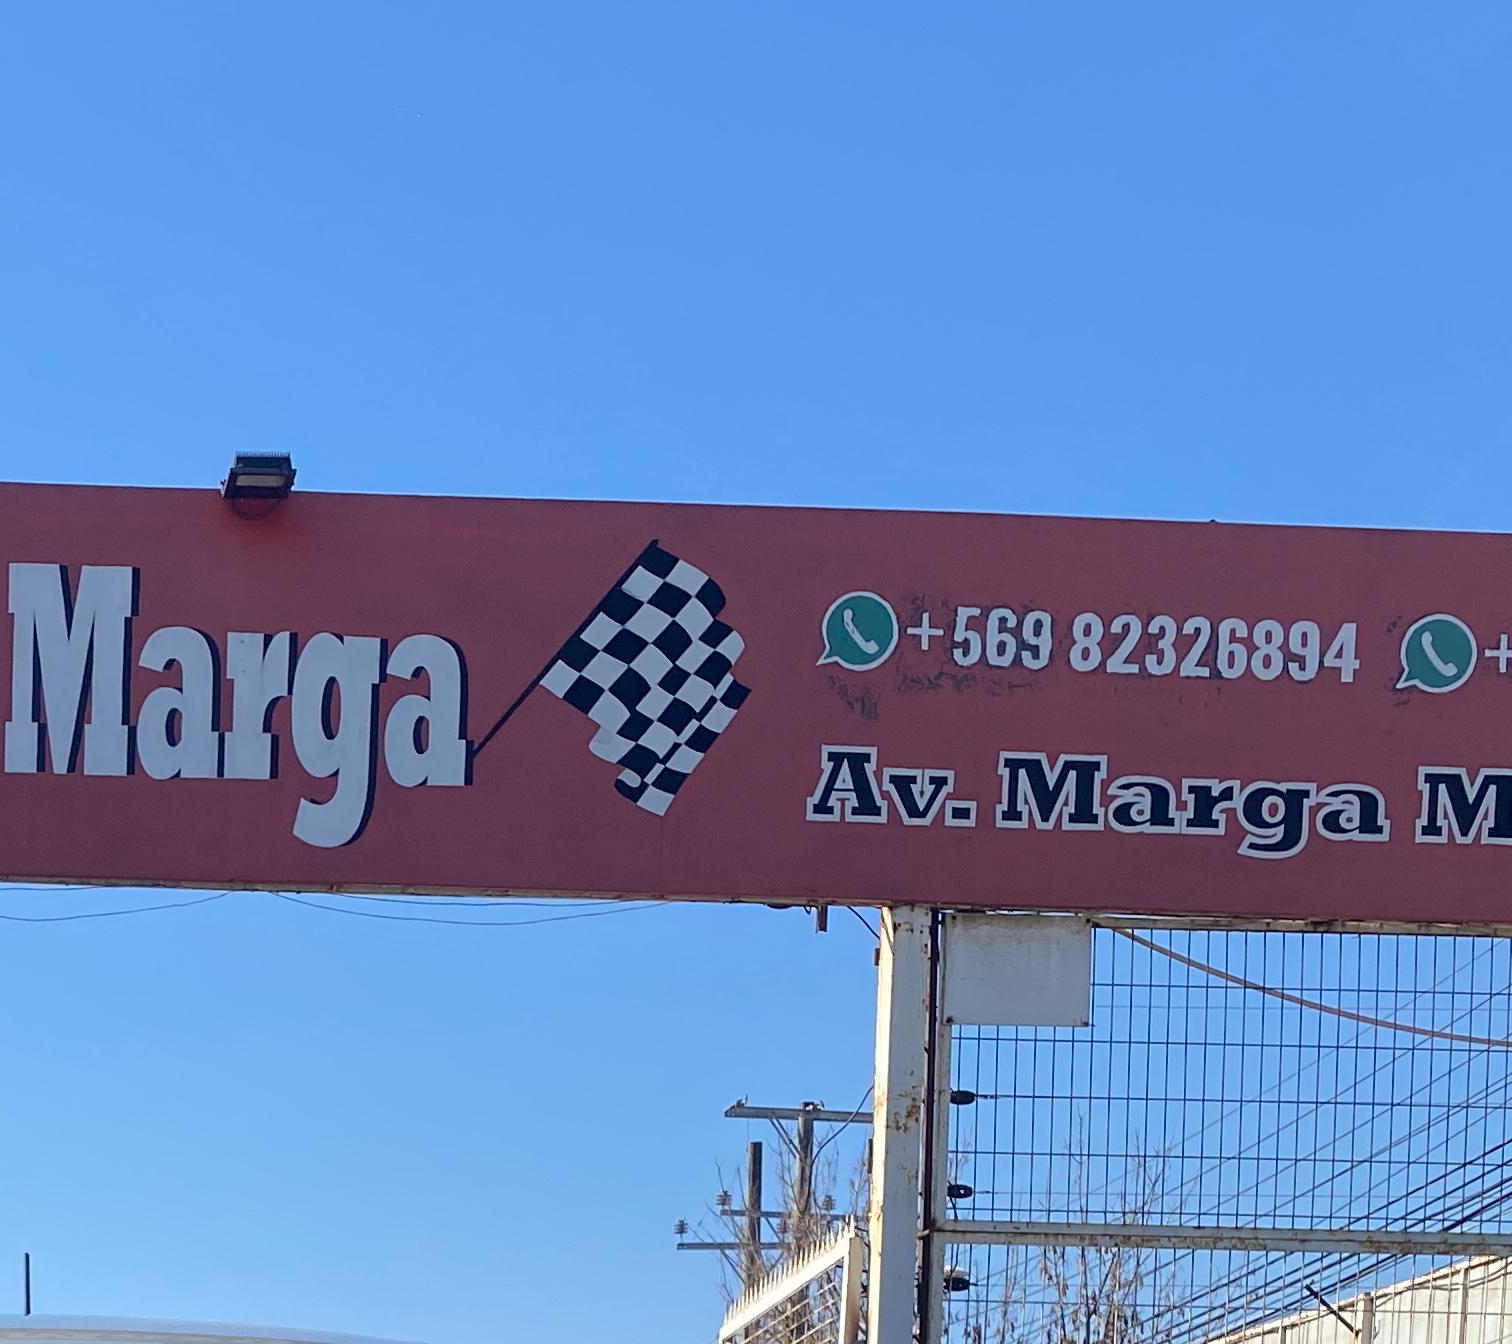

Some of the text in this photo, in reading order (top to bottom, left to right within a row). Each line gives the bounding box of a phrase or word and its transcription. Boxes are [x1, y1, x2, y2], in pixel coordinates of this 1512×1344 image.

[907, 606, 1360, 683] +569 82326894
[4, 562, 472, 849] Marga
[806, 744, 977, 829] Av.
[996, 751, 1390, 860] Marga
